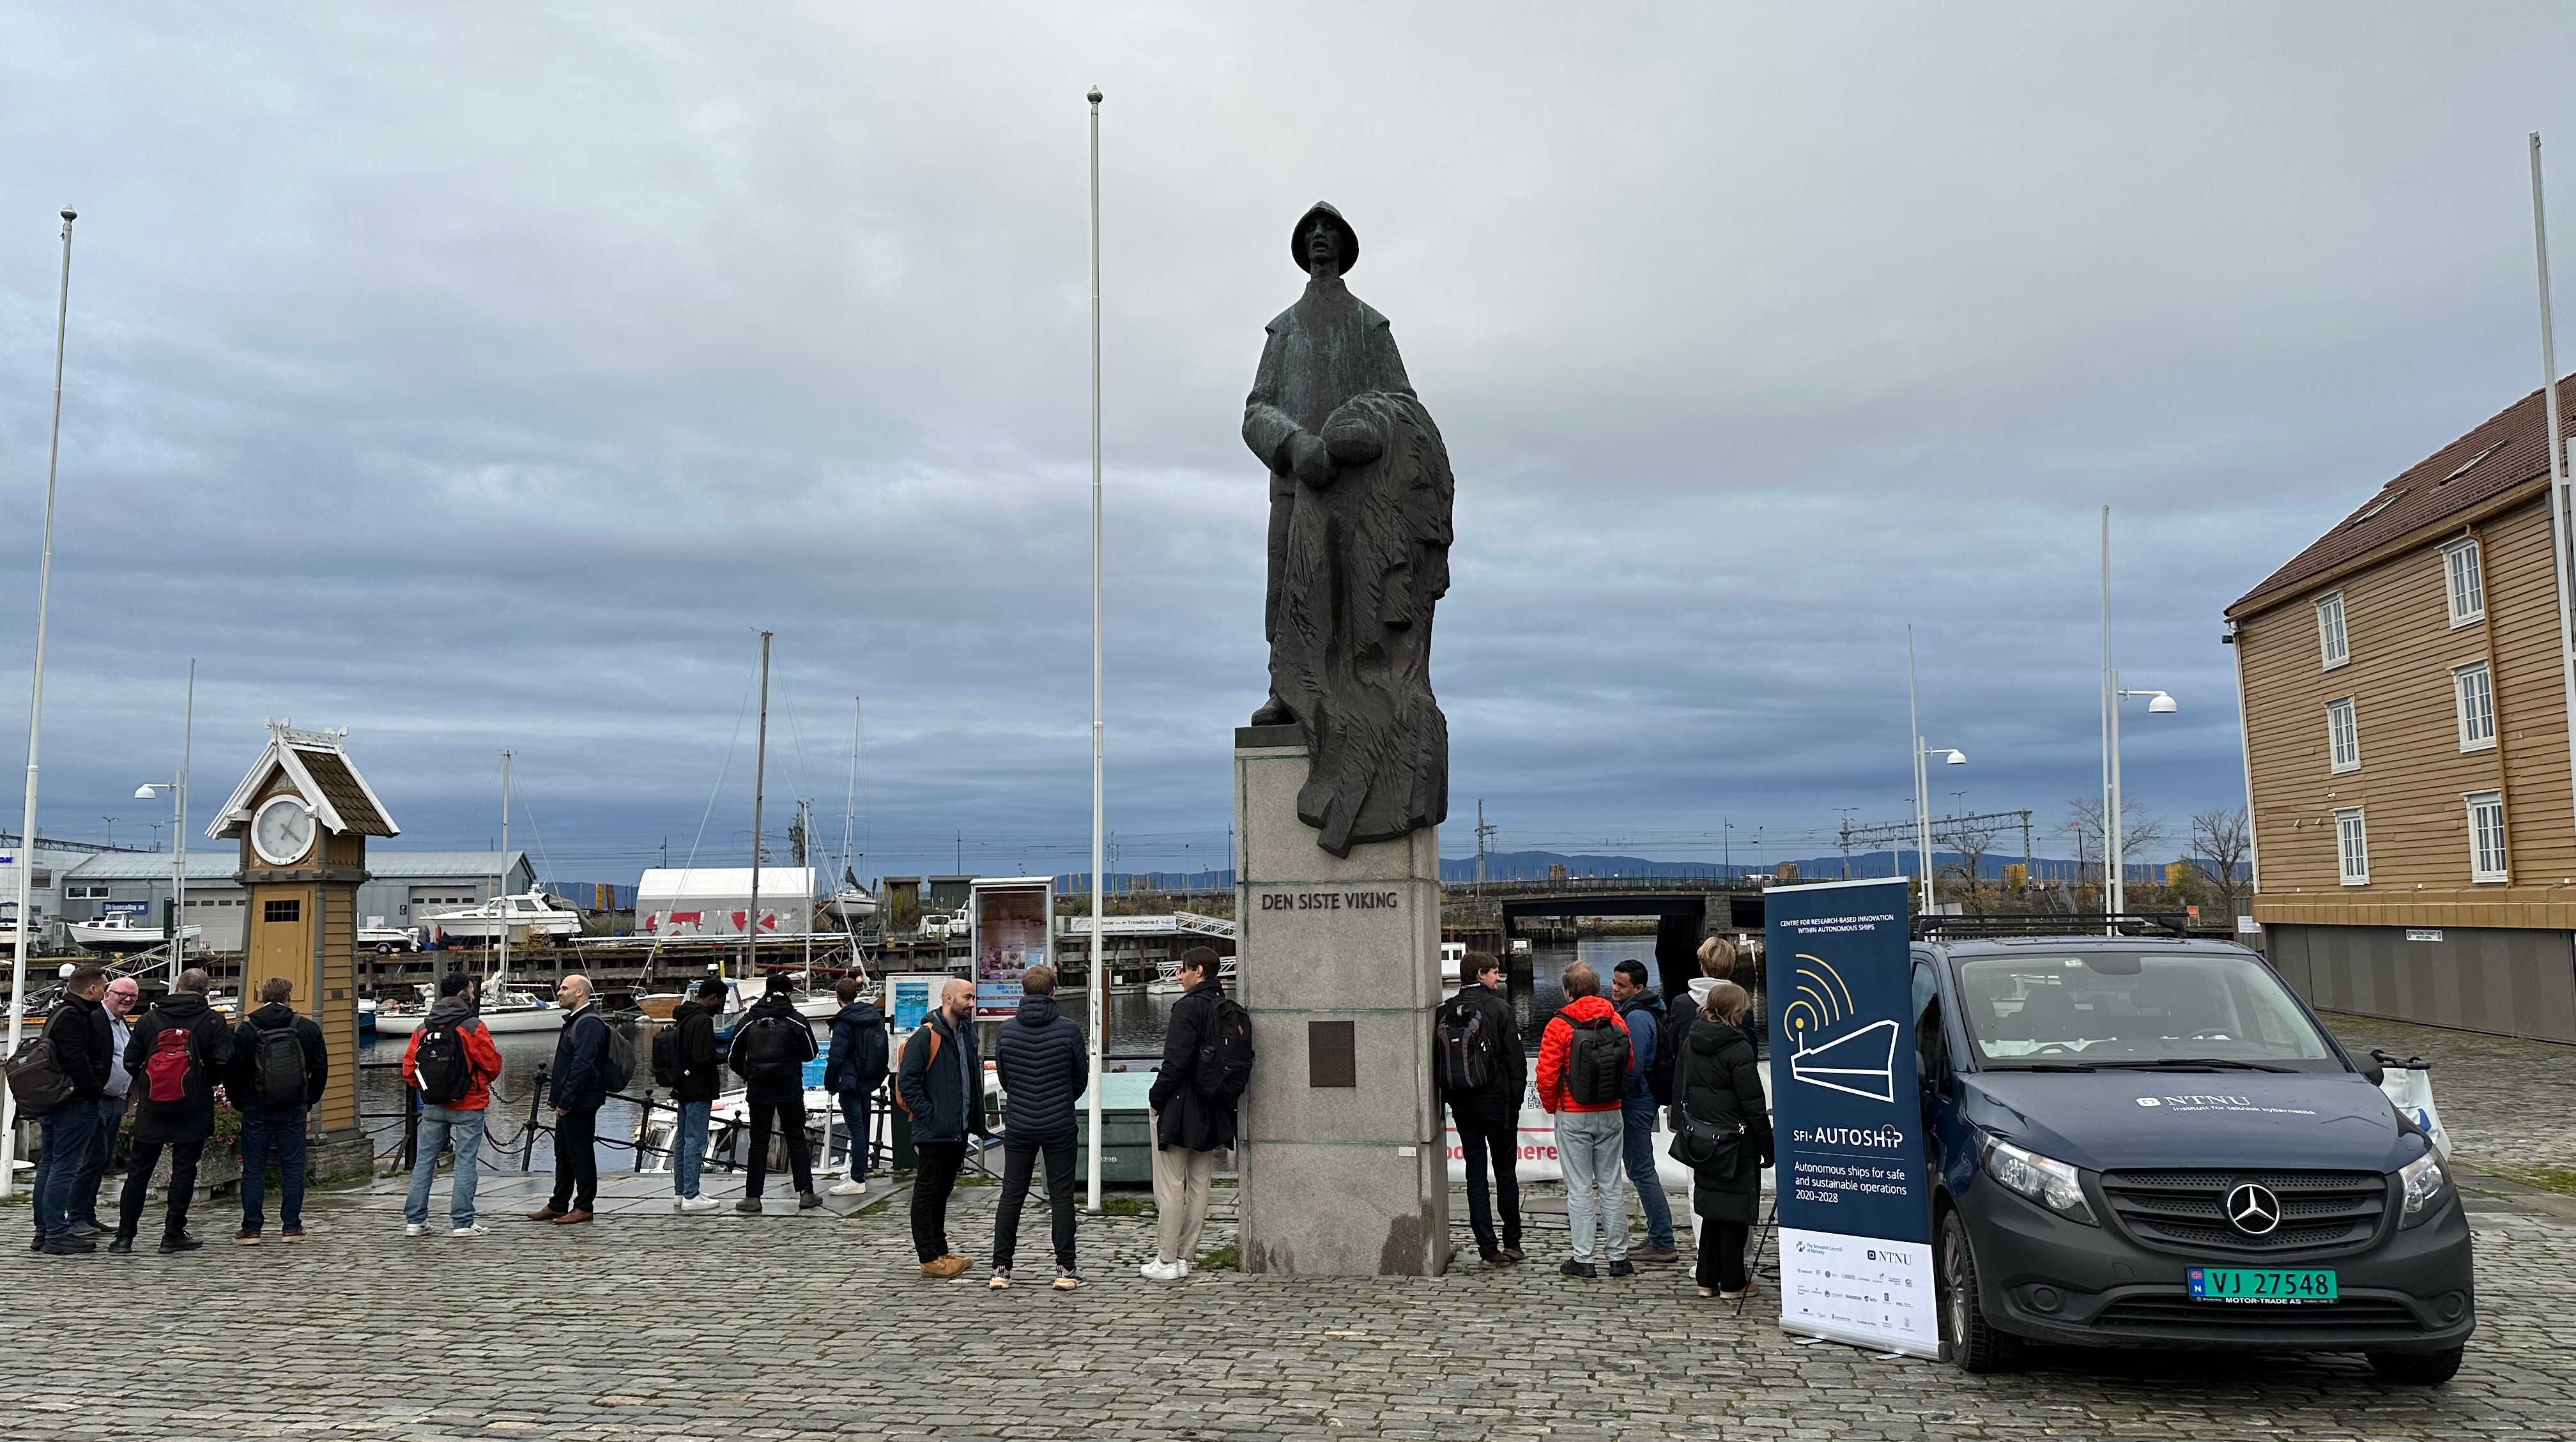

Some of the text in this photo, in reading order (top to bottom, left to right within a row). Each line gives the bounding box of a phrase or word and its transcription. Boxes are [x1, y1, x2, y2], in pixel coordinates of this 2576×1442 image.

[1262, 892, 1397, 910] DEN SISTE VIKING
[1811, 916, 1857, 925] RESEARCH-BASED
[1858, 914, 1894, 923] INNOVATION
[1818, 924, 1857, 933] AUTONOMOUS
[2163, 1095, 2251, 1106] NTNU
[2261, 1107, 2317, 1115] kybernetikk
[1814, 1126, 1903, 1148] AUTOSHIP
[1795, 1161, 1905, 1180] Autonomous ships for safe
[1795, 1176, 1907, 1195] and sustainable operations
[1878, 1250, 1912, 1266] NTNU
[2212, 1272, 2329, 1295] VJ 27548
